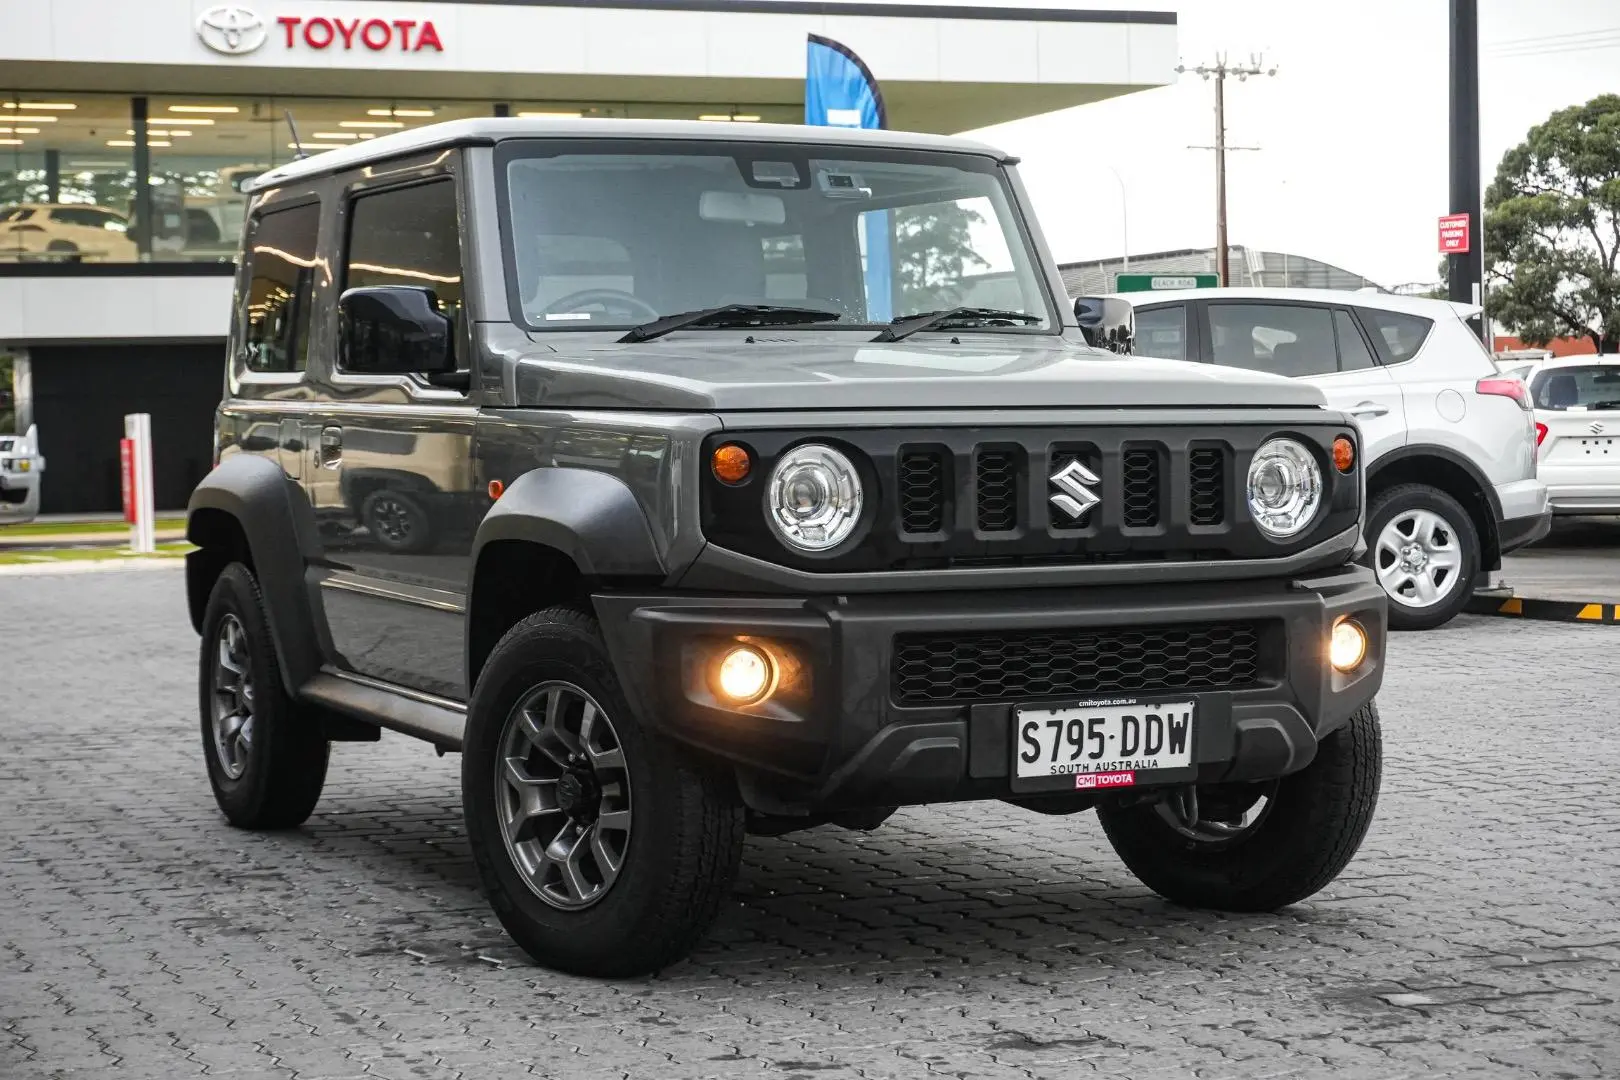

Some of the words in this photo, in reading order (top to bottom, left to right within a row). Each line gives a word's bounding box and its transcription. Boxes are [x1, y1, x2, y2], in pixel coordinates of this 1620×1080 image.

[277, 16, 444, 52] TOYOTA
[1440, 220, 1466, 229] CUSTOMER
[1441, 230, 1464, 238] PARKING
[1445, 239, 1459, 247] ONLY
[1078, 699, 1137, 708] cmitoyota.com.au
[1050, 764, 1090, 775] SOUTH
[1095, 759, 1159, 771] AUSTRALIA
[1077, 776, 1096, 788] CMI
[1097, 774, 1133, 785] TOYOTA
